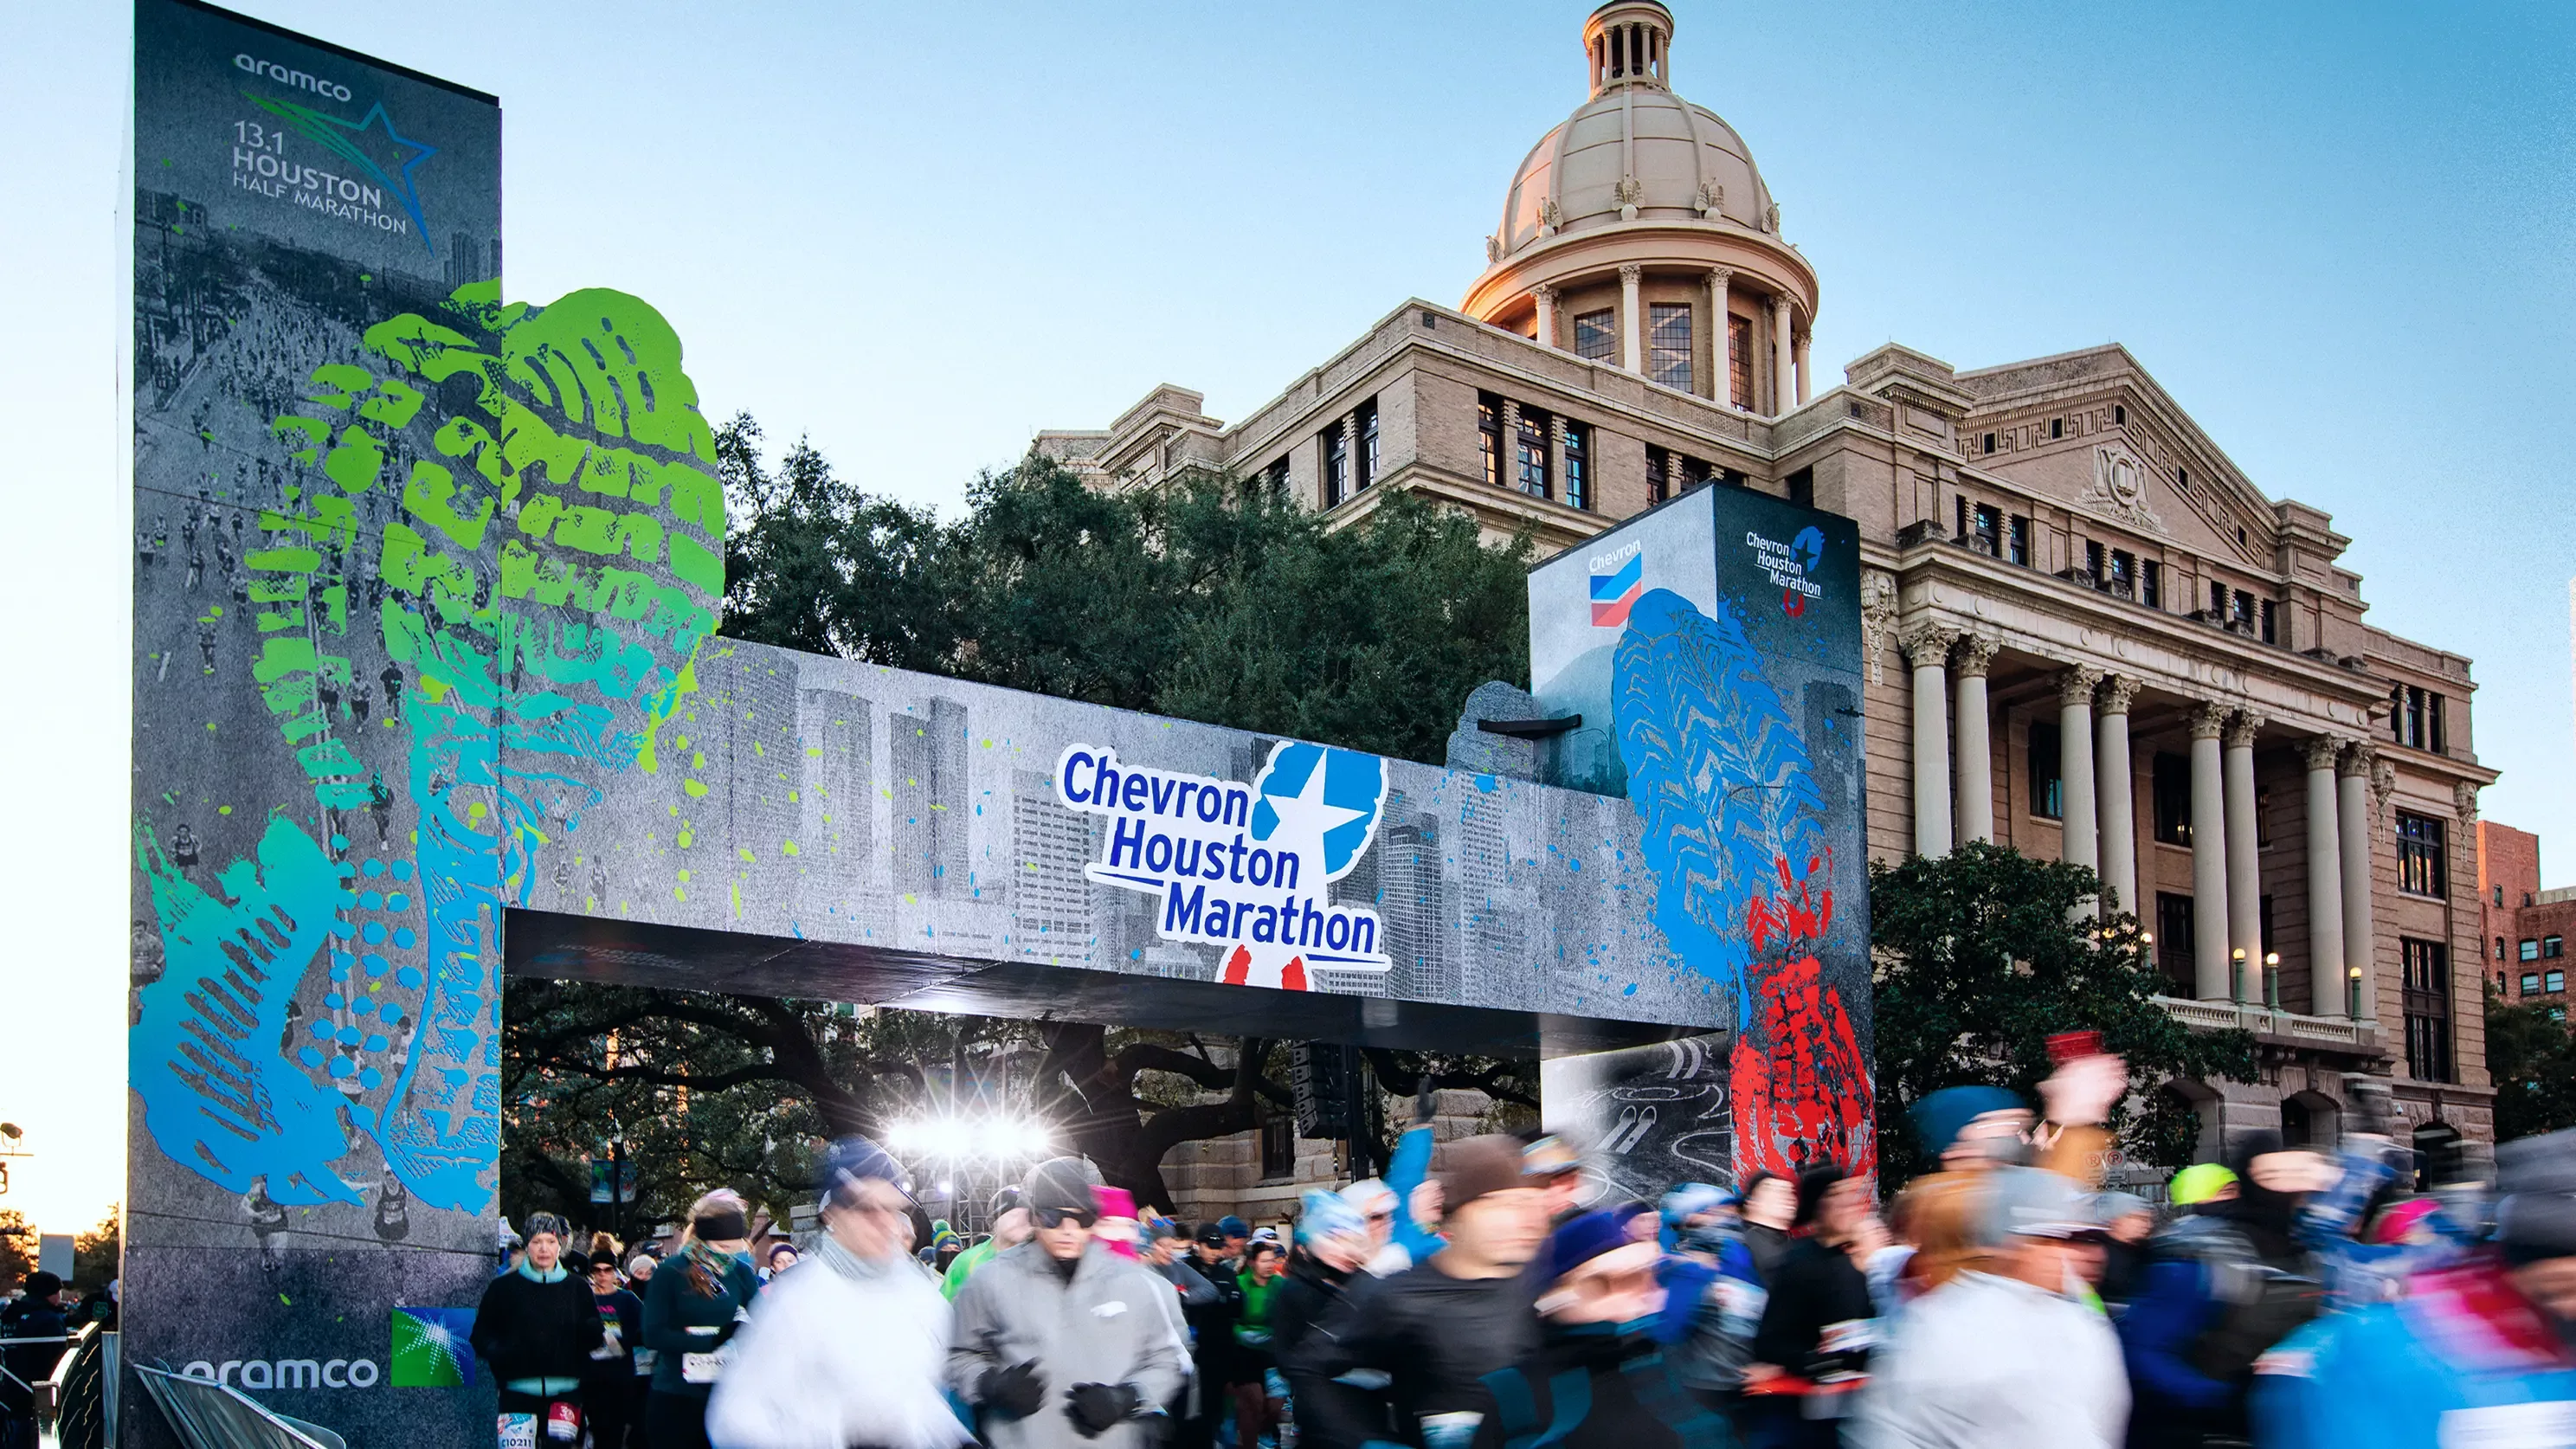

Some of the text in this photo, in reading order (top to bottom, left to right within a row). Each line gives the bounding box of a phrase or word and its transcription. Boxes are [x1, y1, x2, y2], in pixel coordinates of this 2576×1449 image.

[235, 54, 352, 102] aramco
[234, 120, 283, 155] 13.1
[233, 146, 381, 209] HOUSTON
[233, 171, 406, 235] HALF MARATHON
[1589, 539, 1641, 572] Chevron
[1746, 531, 1789, 556] Chevron
[1757, 550, 1802, 576] Houston
[1769, 569, 1821, 596] Marathon
[1064, 751, 1249, 828] Chevron
[1110, 817, 1300, 890] Houston
[1165, 882, 1375, 954] Marathon
[182, 1359, 379, 1388] aramco
